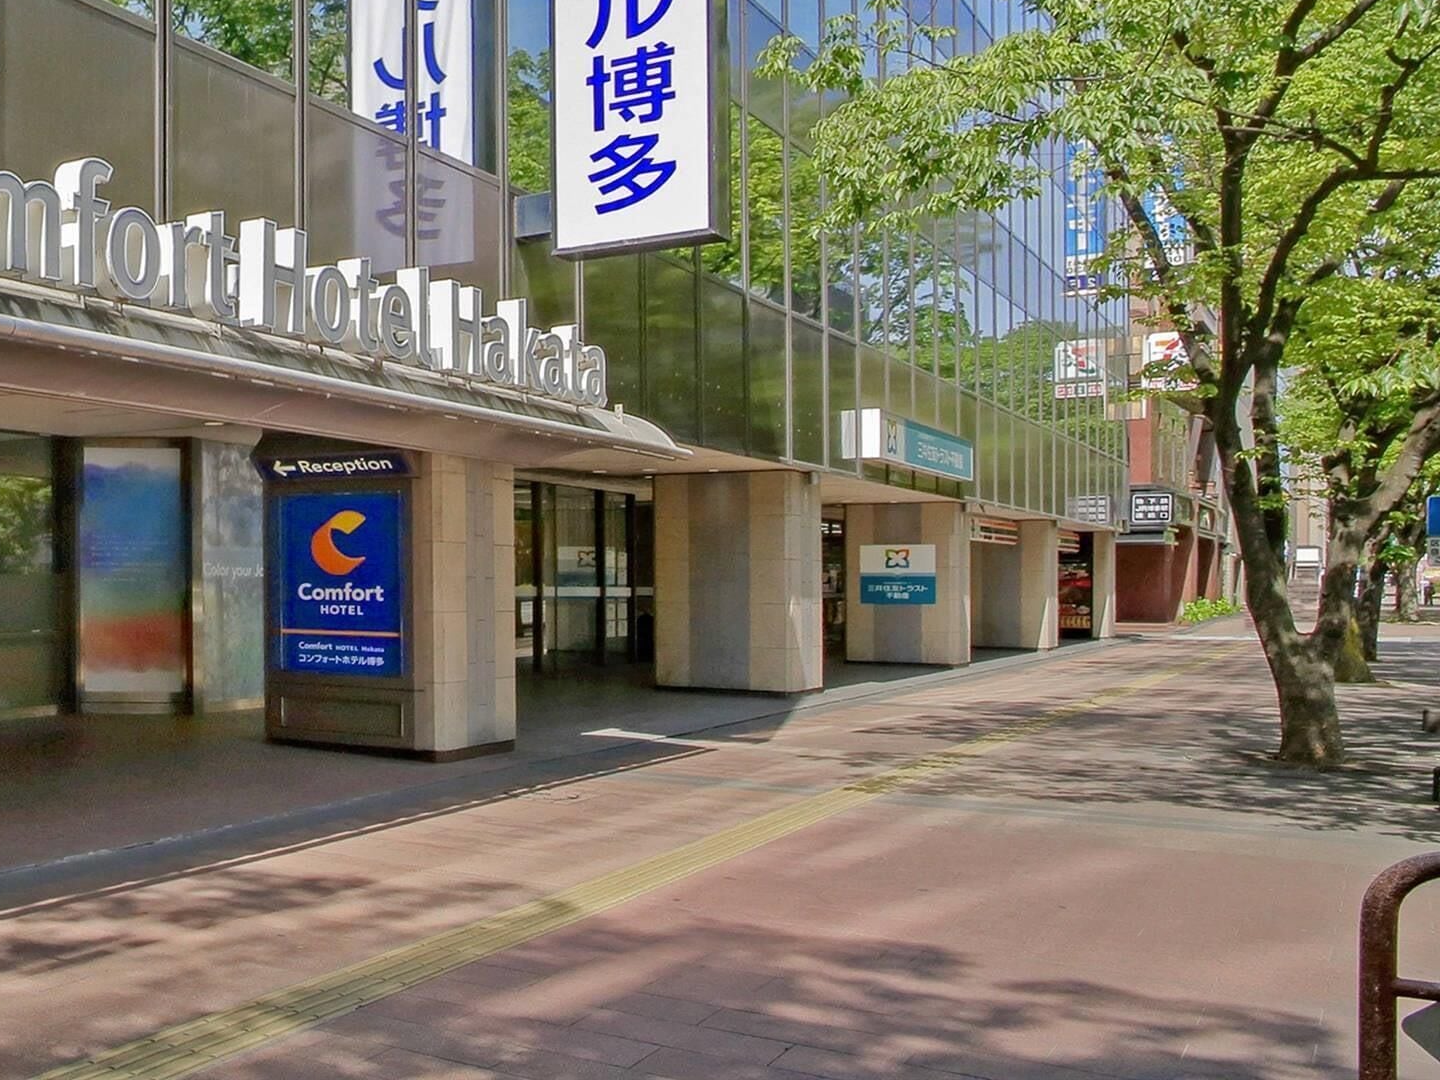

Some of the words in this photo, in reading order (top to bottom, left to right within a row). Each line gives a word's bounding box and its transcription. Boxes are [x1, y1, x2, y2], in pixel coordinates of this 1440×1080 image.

[239, 217, 433, 368] Hotel
[428, 278, 608, 408] Hakata
[297, 457, 393, 475] Reception
[231, 567, 252, 580] your
[297, 582, 385, 602] Comfort
[320, 604, 364, 616] HOTEL
[298, 641, 333, 650] Comfort
[298, 654, 385, 666] コンフォートホテル博多
